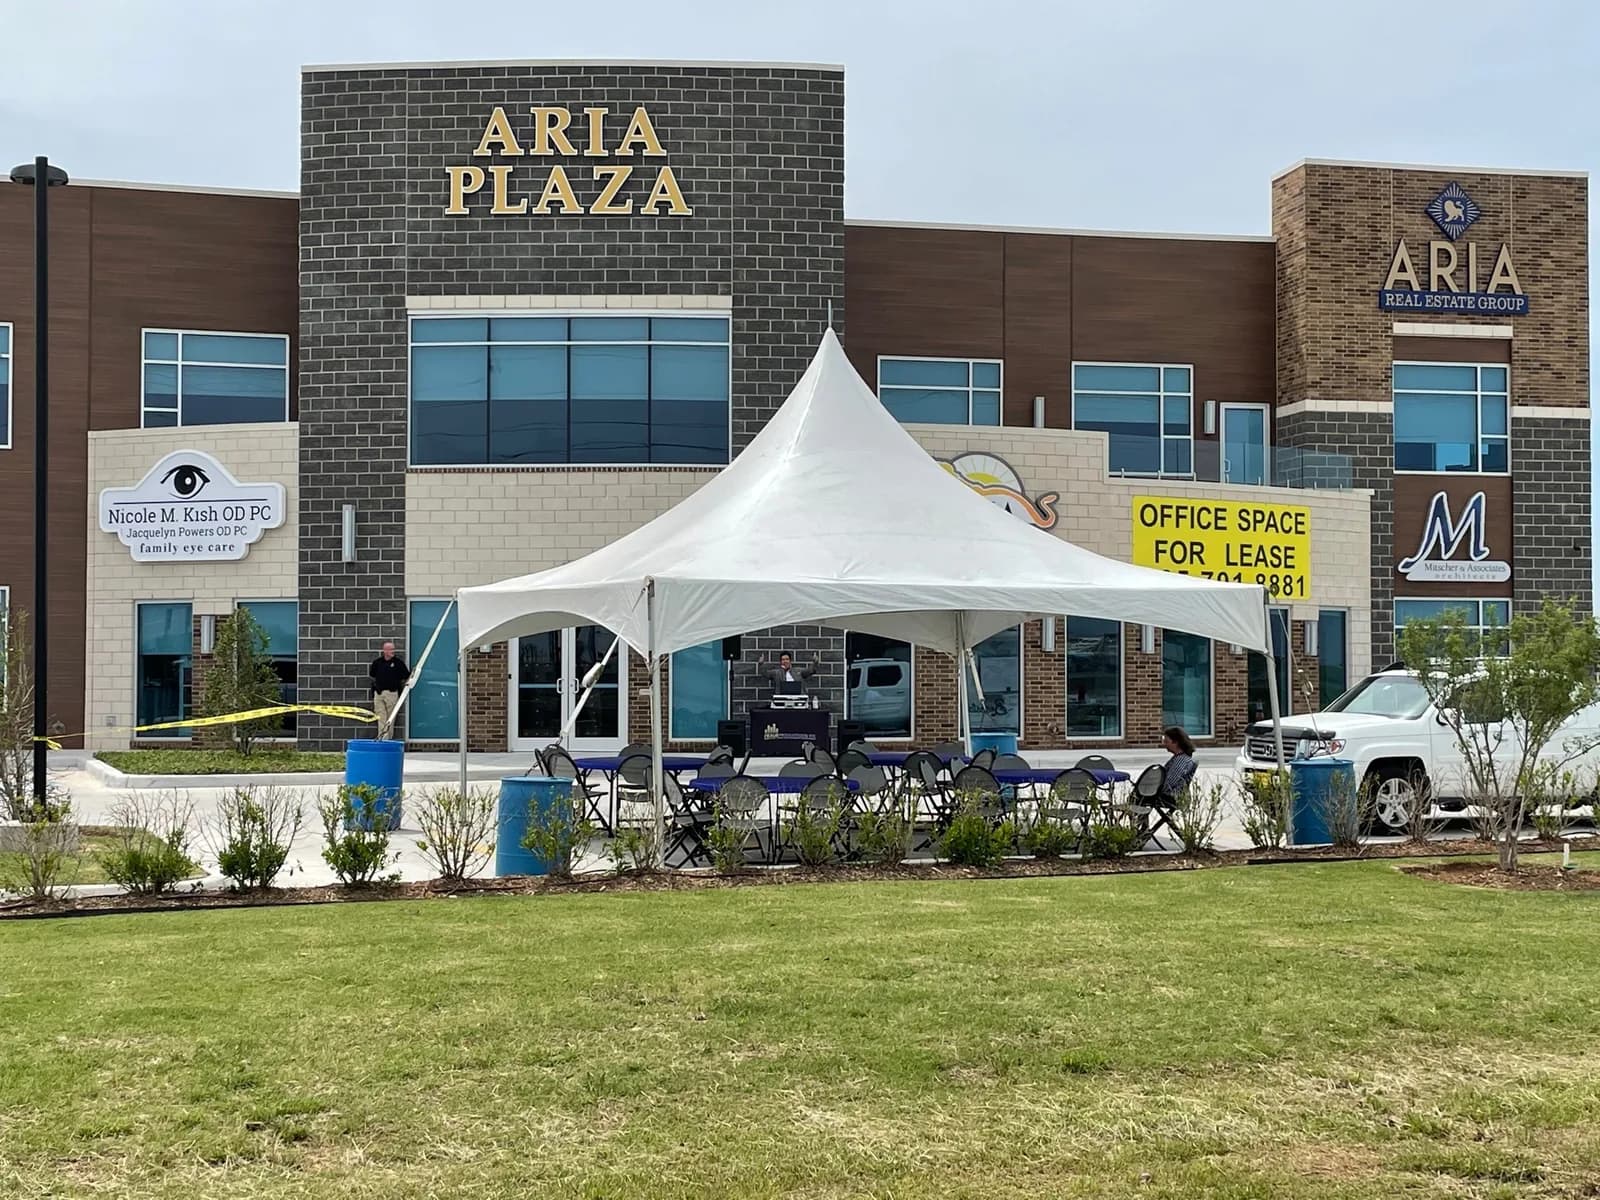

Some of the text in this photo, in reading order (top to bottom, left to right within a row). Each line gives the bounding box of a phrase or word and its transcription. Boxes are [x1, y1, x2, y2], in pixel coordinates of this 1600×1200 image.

[473, 106, 667, 156] ARIA
[445, 165, 693, 216] PLAZA
[1383, 238, 1524, 295] ARIA
[1385, 293, 1524, 311] REAL ESTATE GROUP
[108, 505, 272, 524] Nicole M. Kish OD PC
[1140, 503, 1306, 535] OFFICE SPACE
[126, 525, 248, 540] Jacquelyn Powers OD PC
[140, 542, 235, 555] family eye care
[1154, 540, 1296, 569] FOR LEASE
